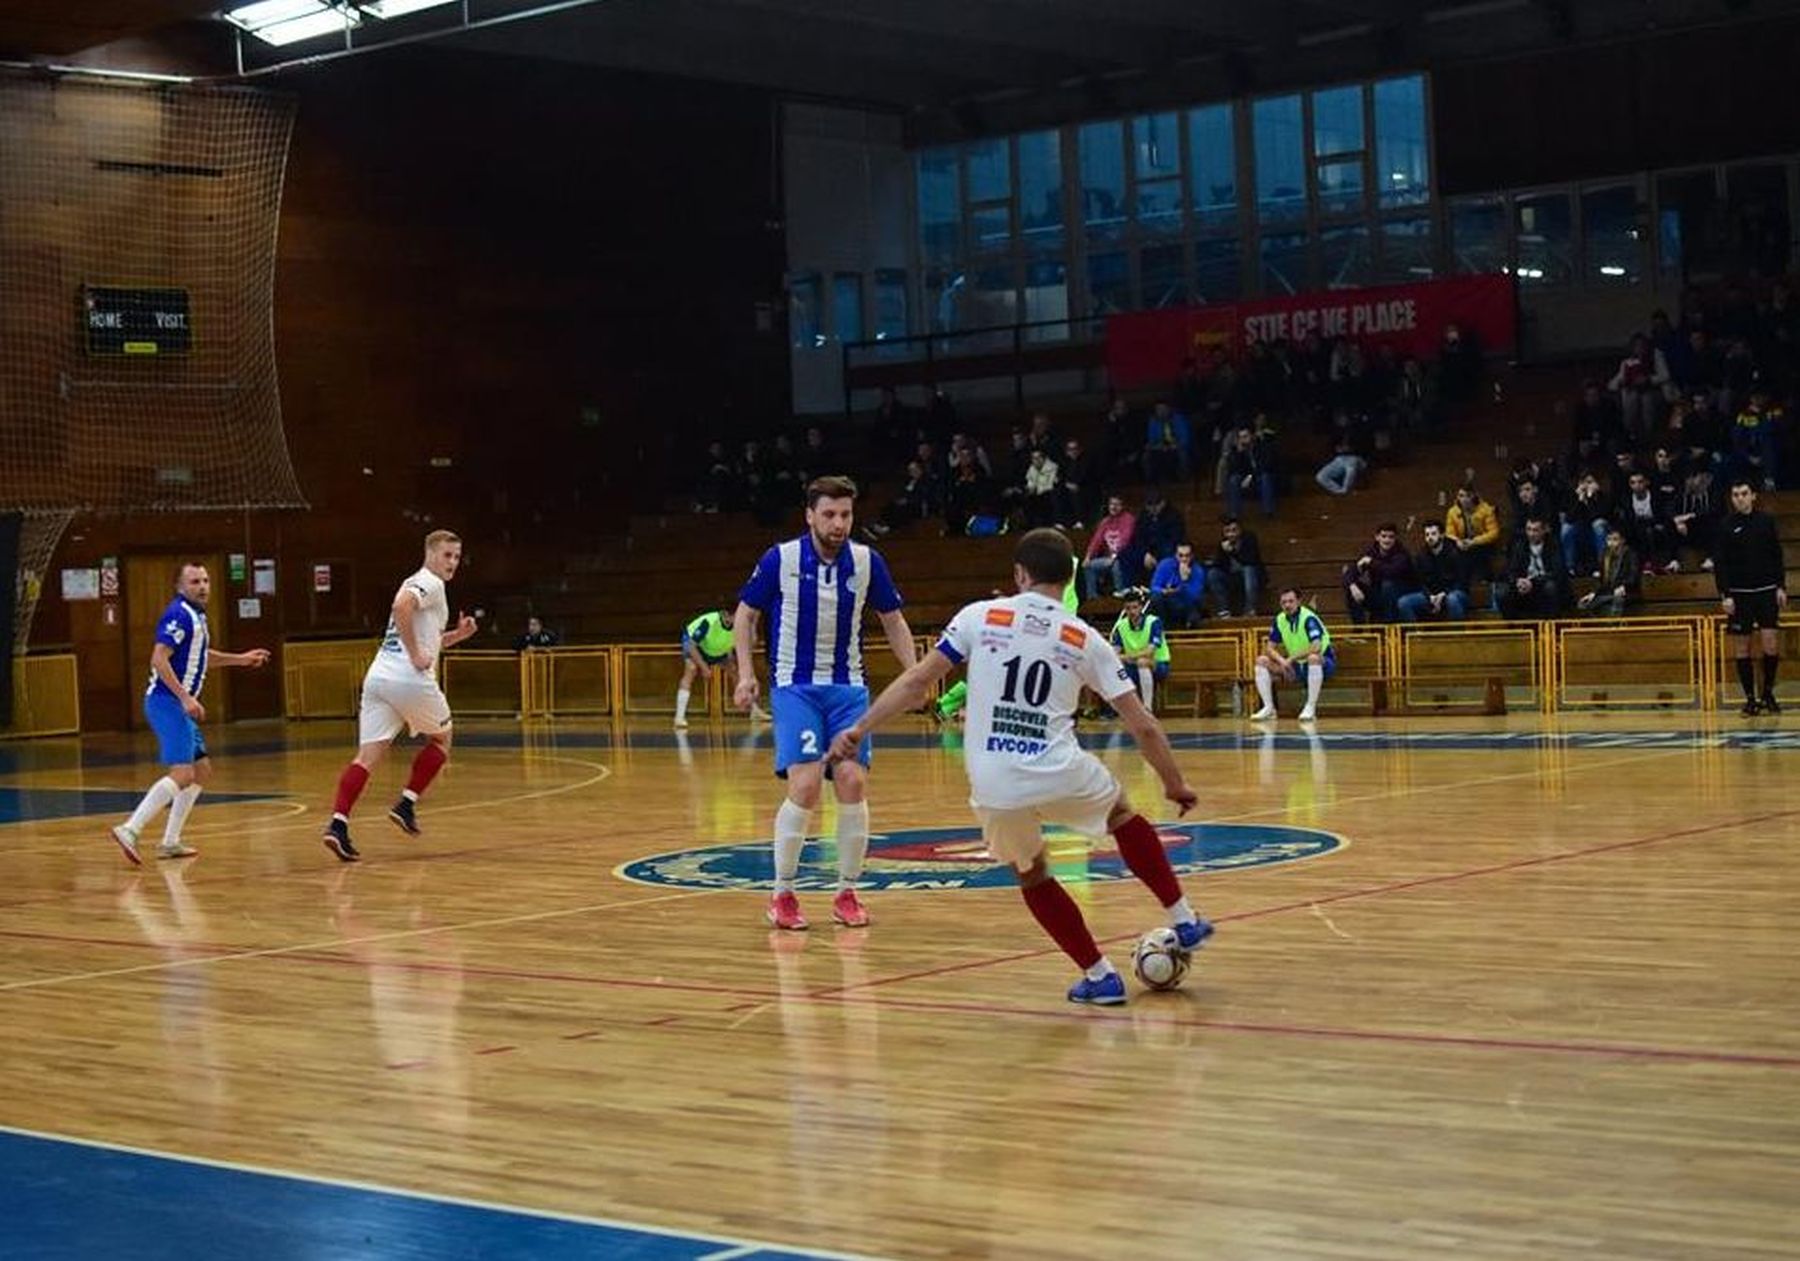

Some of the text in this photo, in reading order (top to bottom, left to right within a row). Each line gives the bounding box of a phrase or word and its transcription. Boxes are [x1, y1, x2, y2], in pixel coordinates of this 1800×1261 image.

[90, 311, 122, 329] HOME
[1352, 299, 1416, 334] PLACE
[1000, 655, 1052, 707] 10
[993, 705, 1049, 726] DISCOVER
[801, 730, 817, 754] 2
